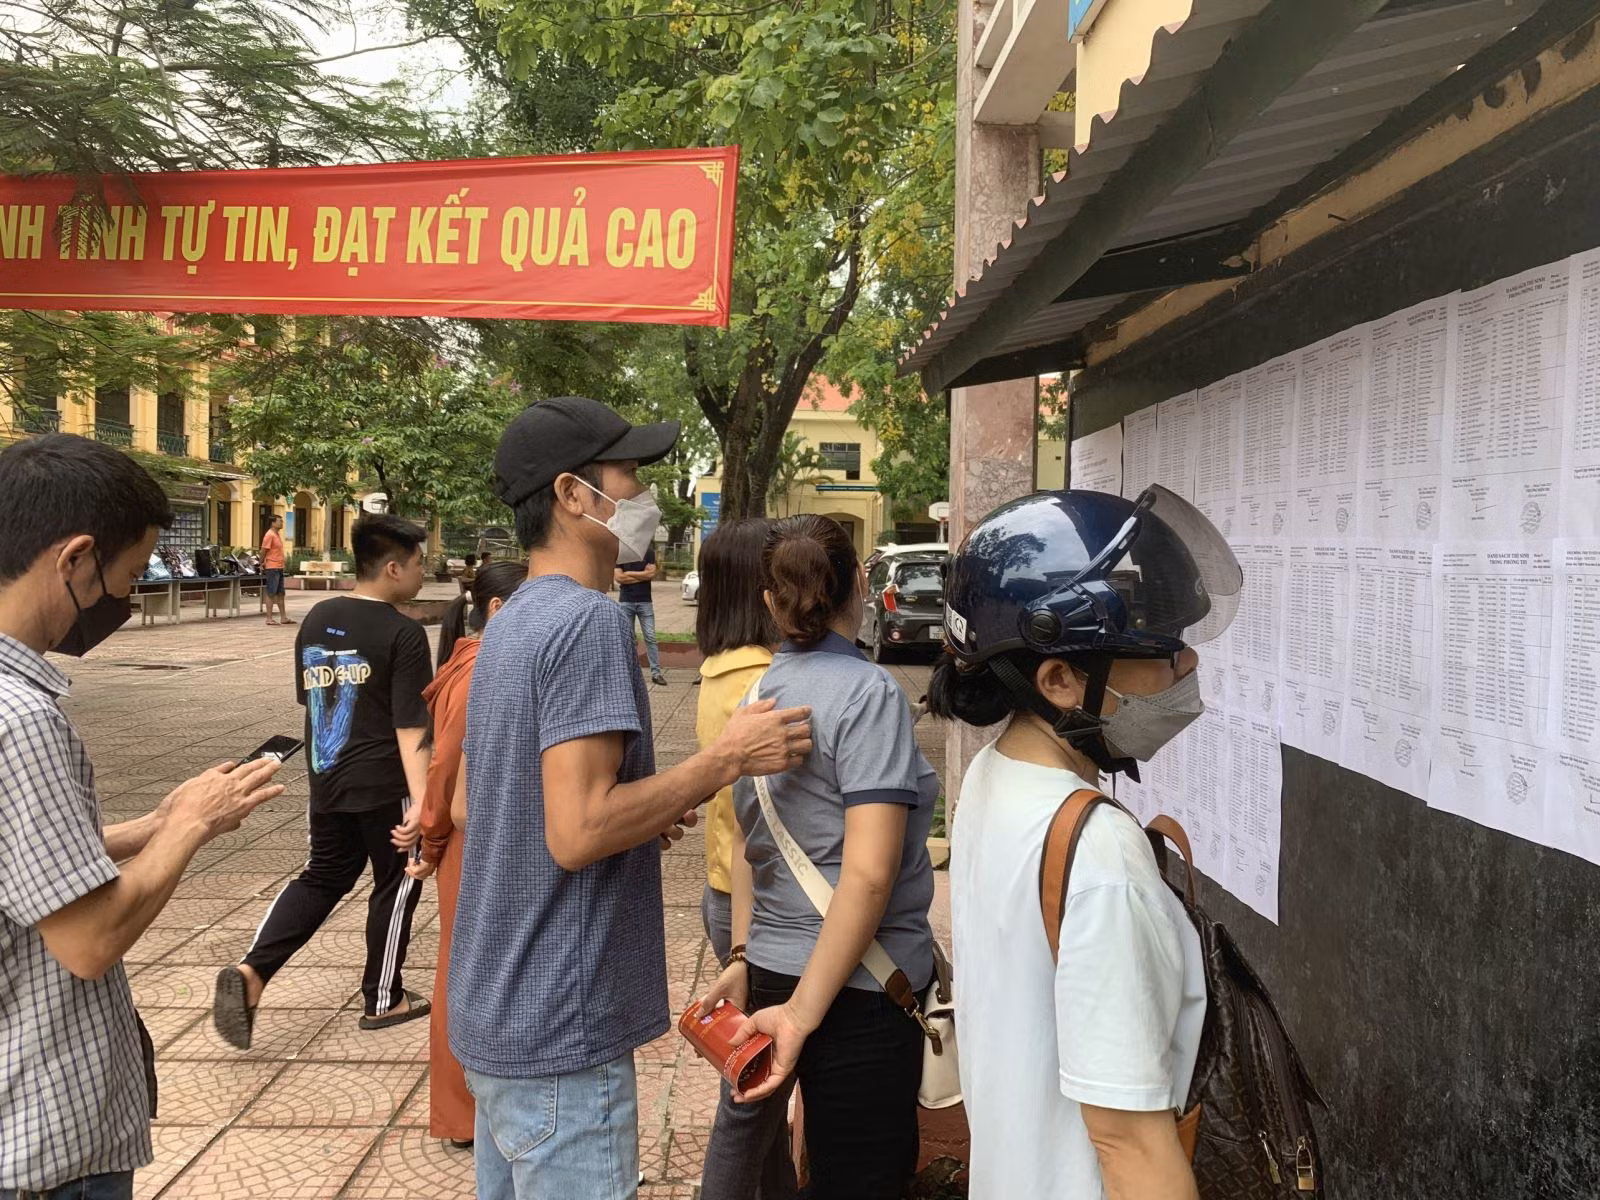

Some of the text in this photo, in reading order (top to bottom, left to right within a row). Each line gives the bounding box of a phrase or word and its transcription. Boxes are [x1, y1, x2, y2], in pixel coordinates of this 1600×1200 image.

[161, 200, 215, 274] TỰ
[223, 206, 298, 270] TIN,
[313, 206, 396, 276] ĐẠT
[406, 187, 489, 264] KẾT
[500, 187, 589, 272] QUẢ
[605, 207, 697, 270] CAO
